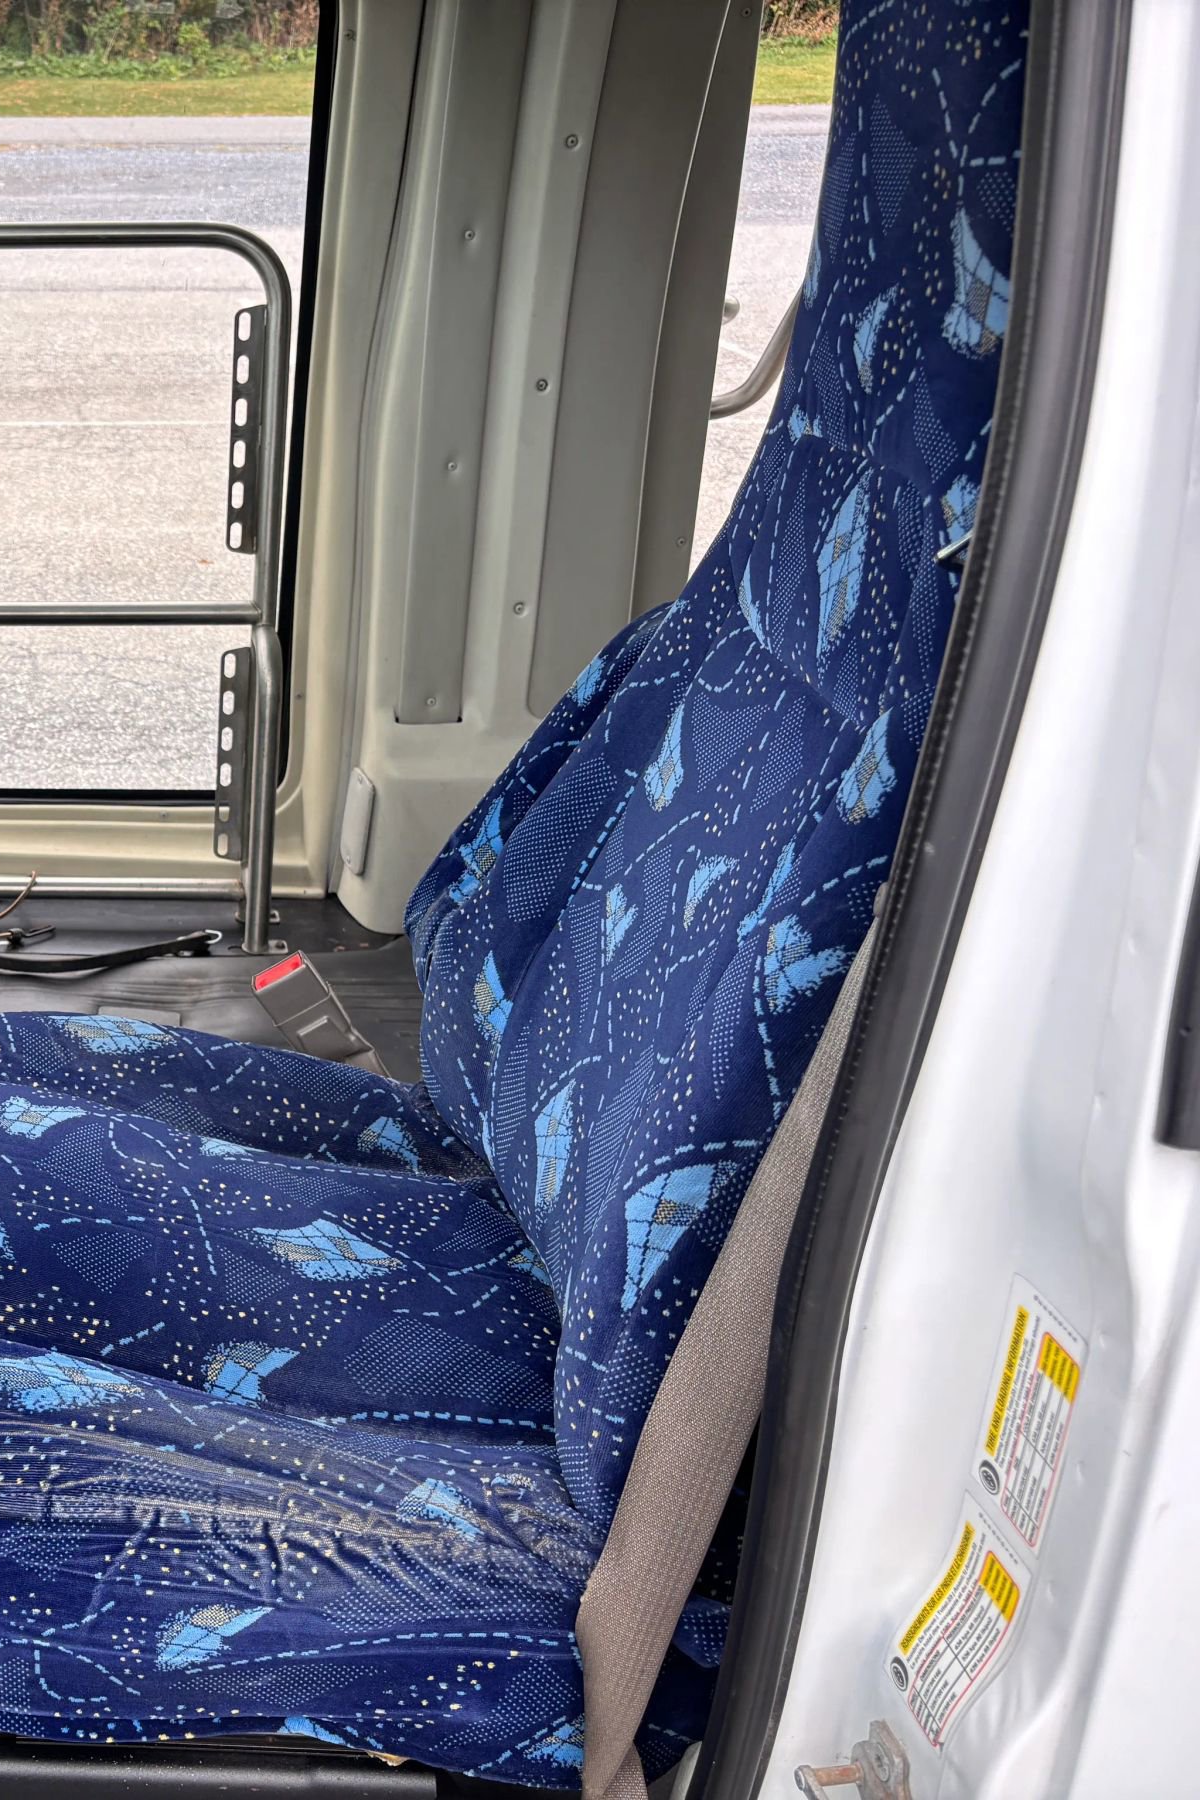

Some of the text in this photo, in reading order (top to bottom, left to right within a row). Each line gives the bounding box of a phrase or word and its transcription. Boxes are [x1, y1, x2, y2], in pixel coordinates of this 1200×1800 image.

[1005, 1308, 1025, 1374] INFORMATION
[995, 1370, 1010, 1414] LOADING
[991, 1409, 1000, 1432] AND
[986, 1429, 995, 1453] TIRE
[927, 1598, 936, 1611] SUR
[934, 1587, 944, 1601] LES
